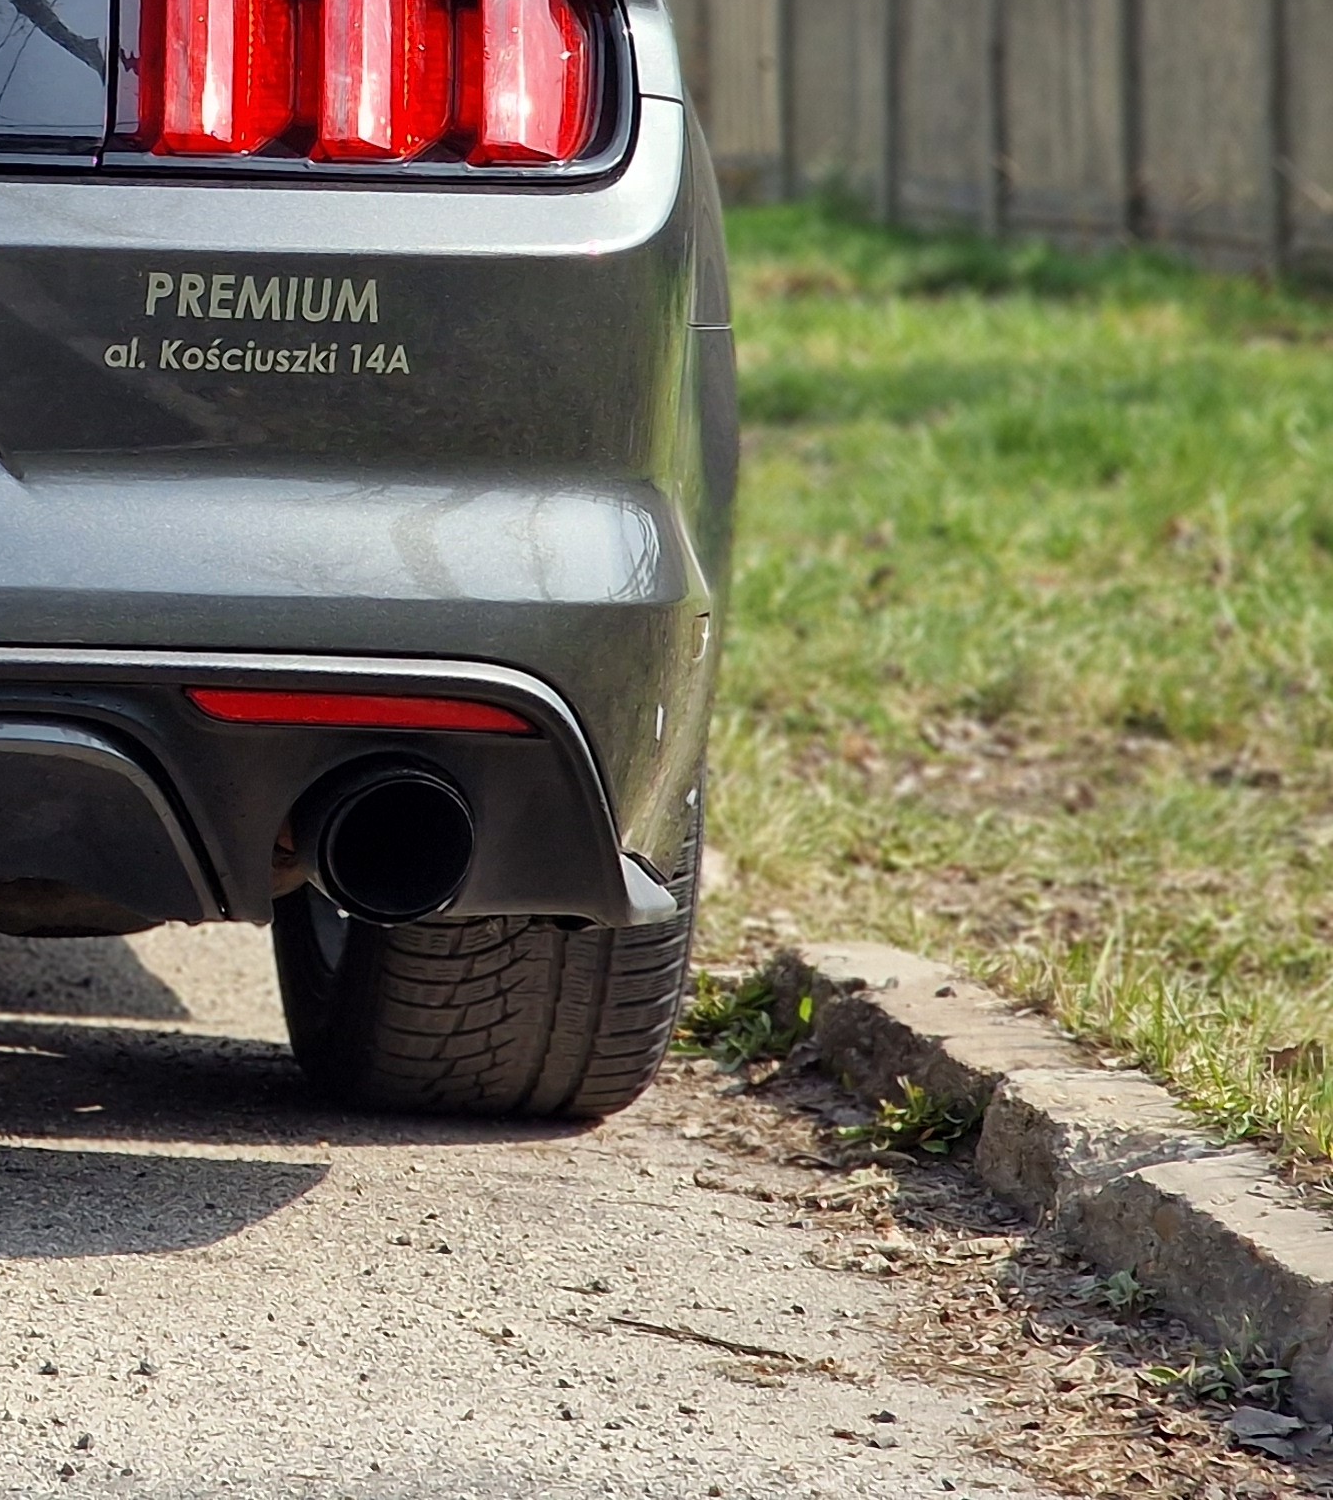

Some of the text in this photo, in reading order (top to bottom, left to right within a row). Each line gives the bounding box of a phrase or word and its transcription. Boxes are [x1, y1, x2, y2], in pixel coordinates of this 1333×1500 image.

[144, 271, 380, 324] PREMIUM
[103, 336, 411, 376] al. Kościuszki 14A
